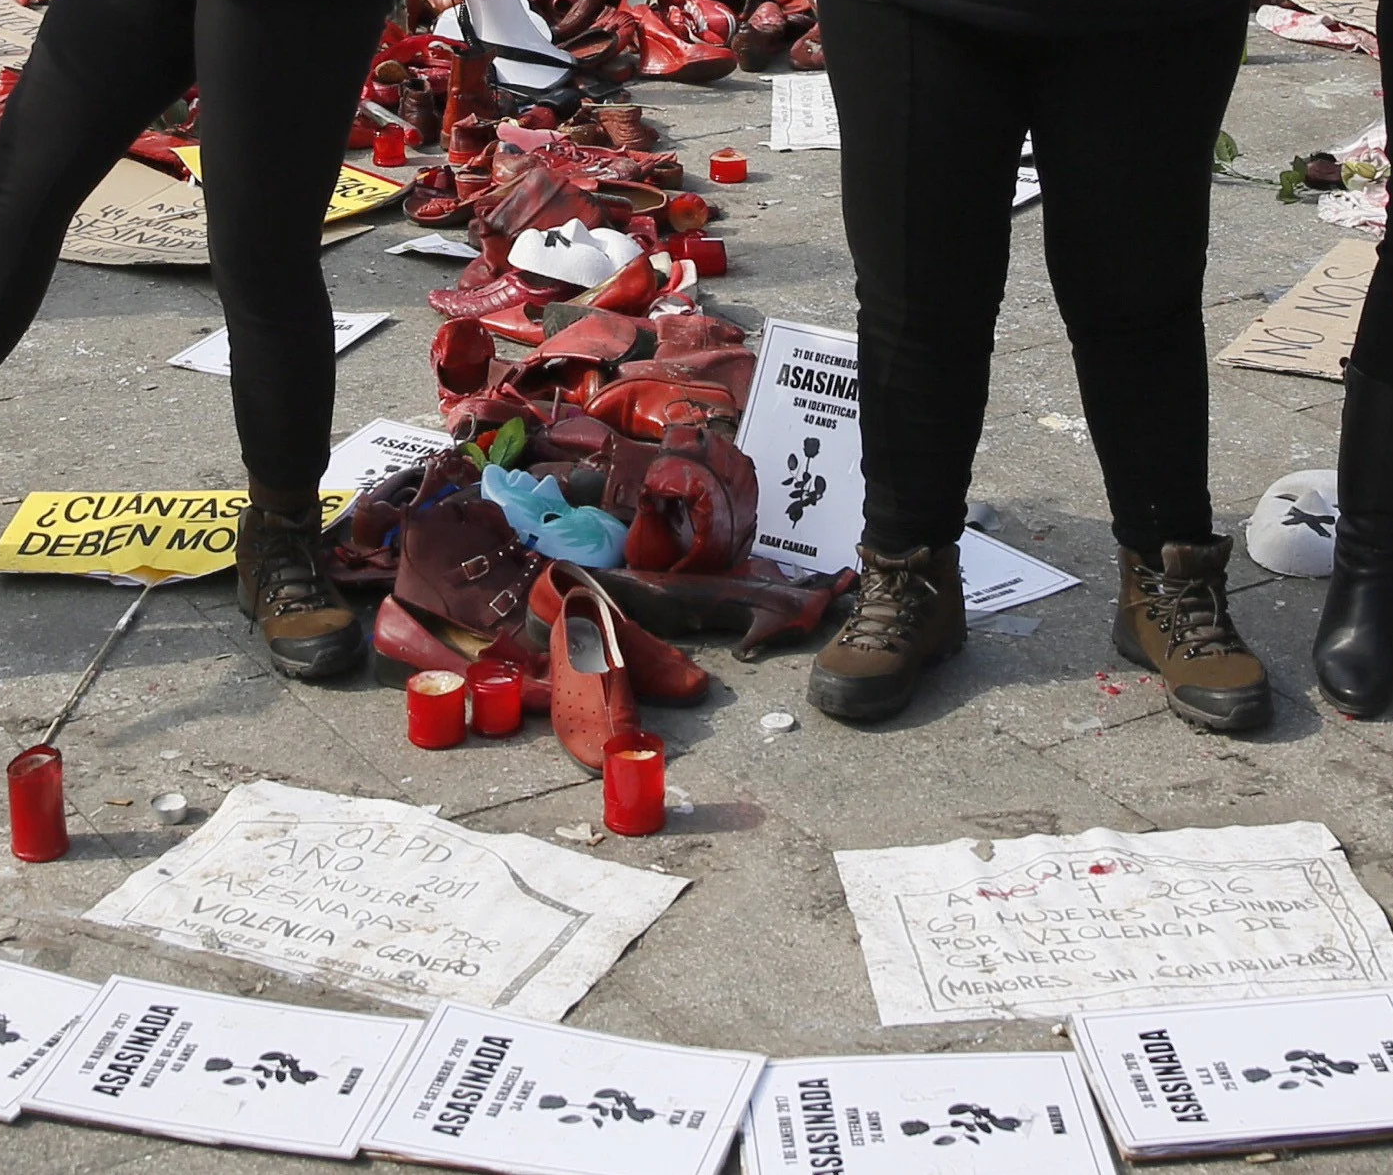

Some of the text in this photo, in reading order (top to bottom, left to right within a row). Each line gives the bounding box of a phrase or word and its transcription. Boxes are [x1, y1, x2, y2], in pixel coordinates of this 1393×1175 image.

[793, 347, 858, 370] 31 DE DECEMBRO
[1245, 326, 1325, 360] NO
[776, 363, 859, 403] ASASINA
[793, 396, 858, 420] SIN IDENTIFICAR
[803, 413, 814, 424] 40
[36, 492, 244, 528] ¿CUÁNTAS
[16, 524, 163, 558] DEBEN
[759, 533, 817, 558] GRAN CANARIA
[261, 838, 365, 874] AÑO
[334, 826, 454, 865] QEPD
[1150, 875, 1255, 902] 2016
[192, 895, 336, 946] VIOLENCIA
[927, 896, 1321, 935] 69 MUJERES ASESINADAS
[927, 915, 1293, 953] POR VIOLENCIA DE
[1090, 968, 1138, 984] SIN
[91, 1004, 181, 1098] ASASINADA
[337, 1066, 365, 1096] MADRID
[431, 1034, 514, 1138] ASASINADA
[1138, 1028, 1210, 1123] ASASINADA
[1047, 1104, 1068, 1136] MADRID
